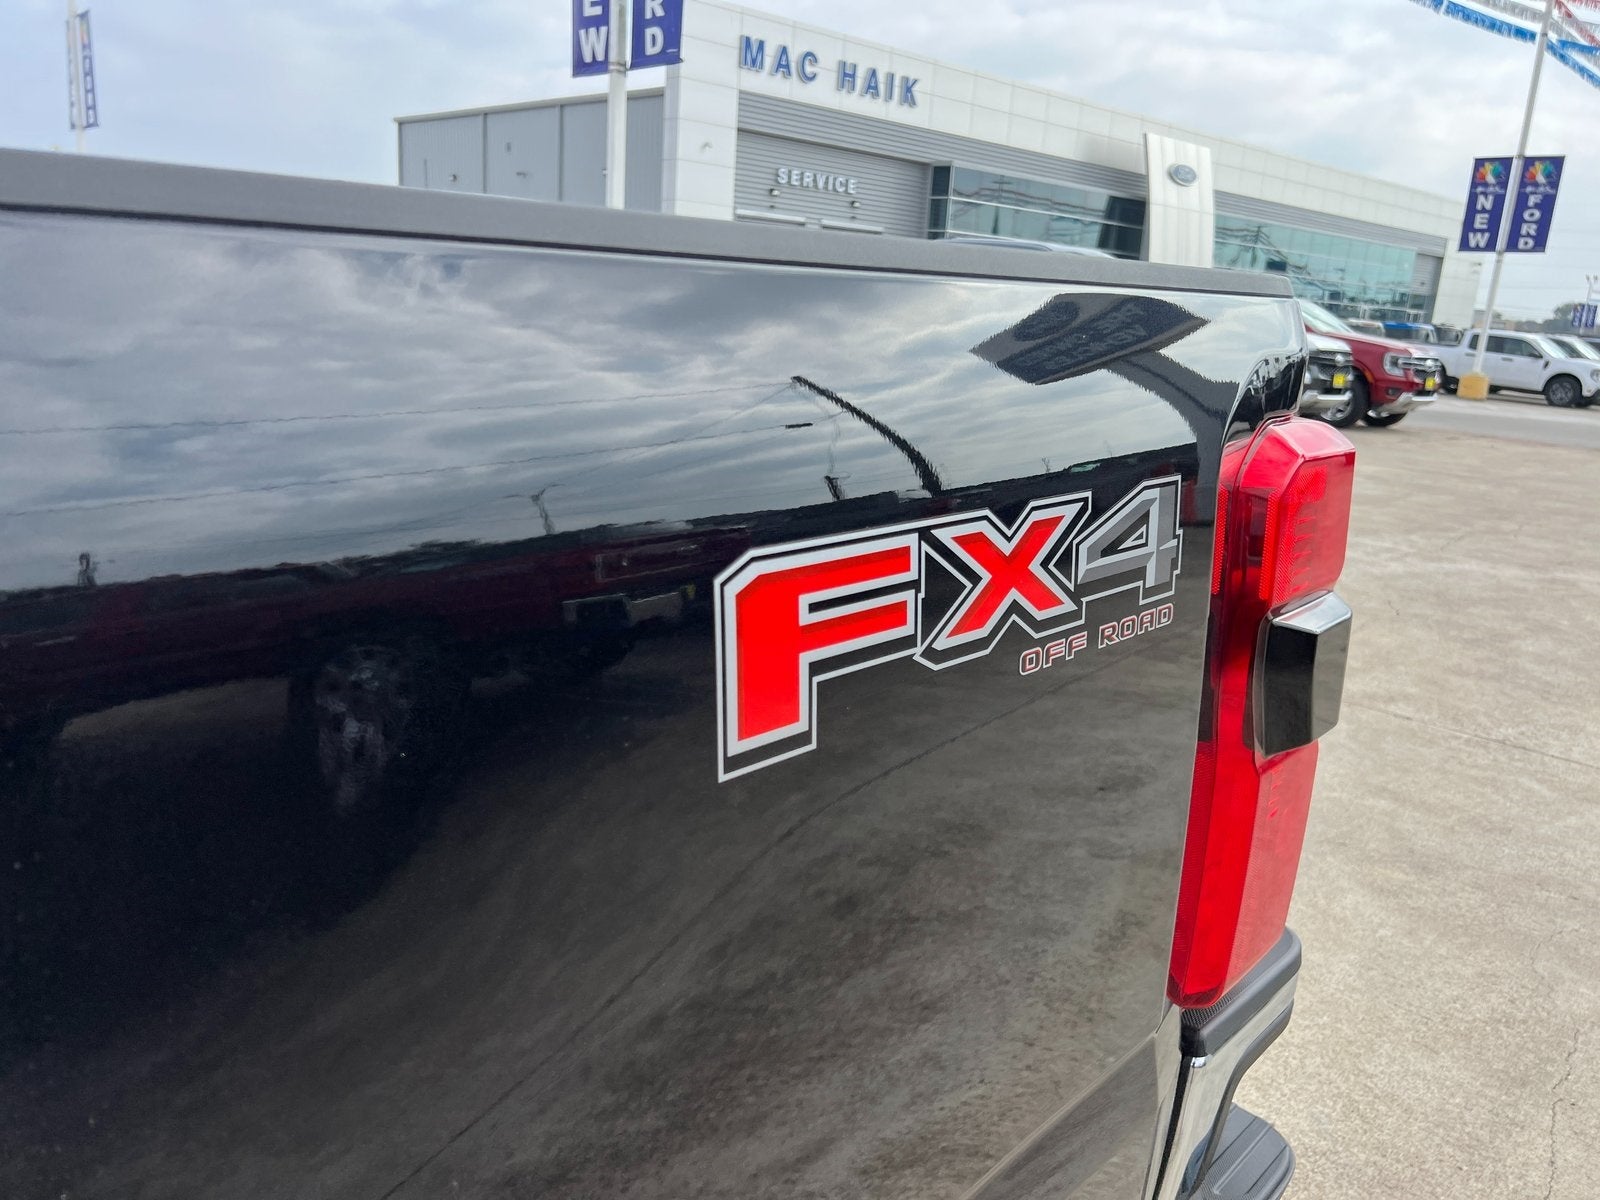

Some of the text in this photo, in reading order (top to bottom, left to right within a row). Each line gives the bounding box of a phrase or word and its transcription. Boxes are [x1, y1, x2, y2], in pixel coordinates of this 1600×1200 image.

[739, 34, 919, 107] MAC HAIK
[777, 167, 857, 194] SERVICE
[1468, 194, 1495, 249] NEW
[1517, 194, 1543, 250] FORD
[714, 474, 1183, 783] FX4
[1019, 603, 1174, 676] OFF ROAD
